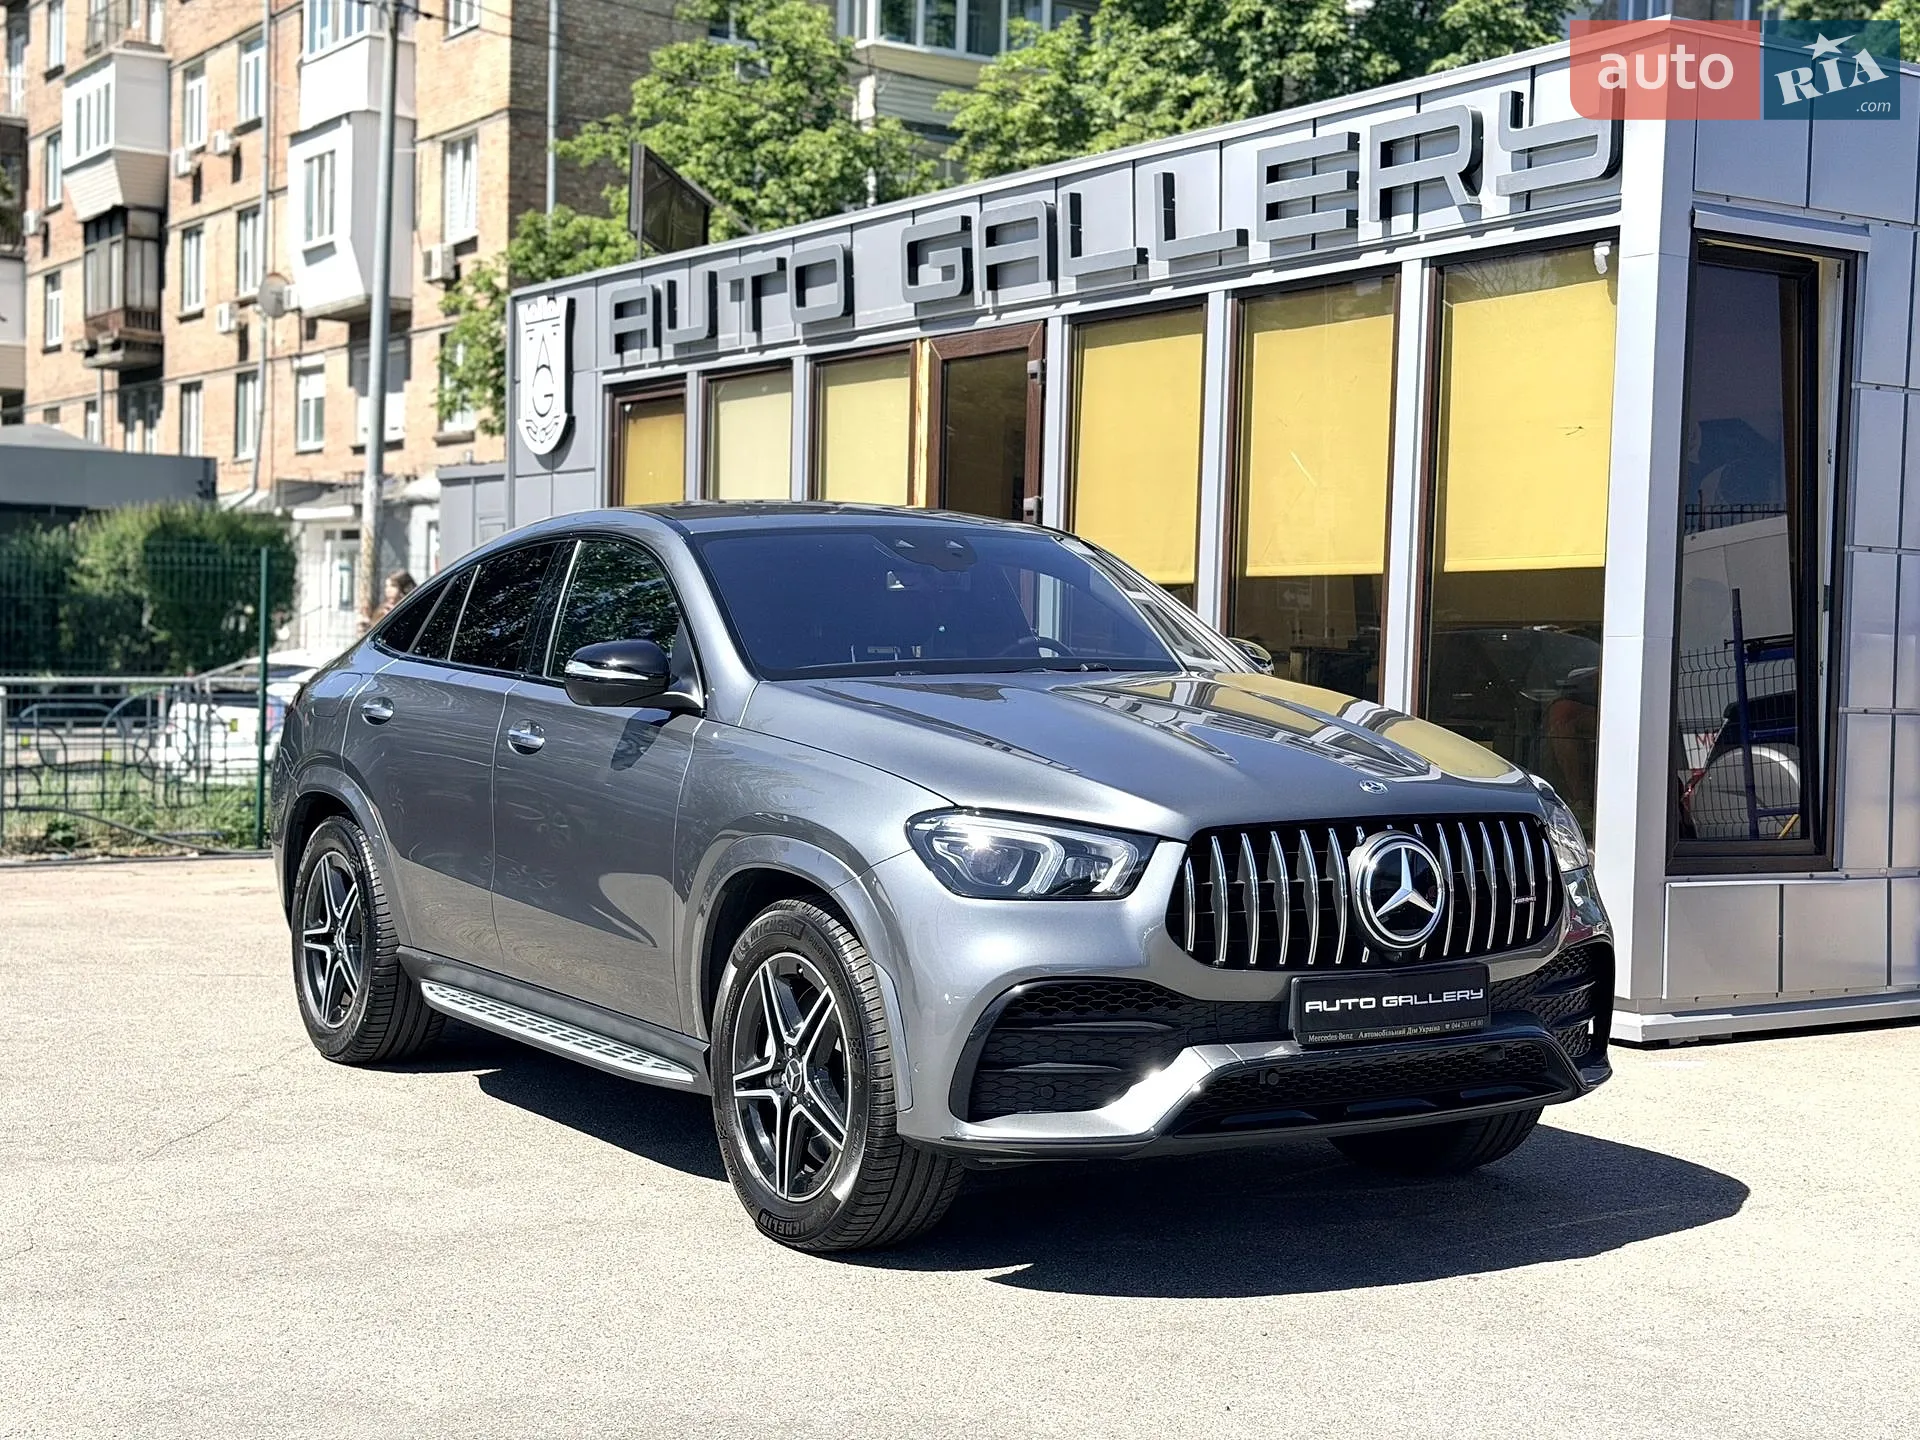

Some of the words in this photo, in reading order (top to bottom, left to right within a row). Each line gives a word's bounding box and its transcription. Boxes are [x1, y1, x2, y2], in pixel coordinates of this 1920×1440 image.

[609, 243, 854, 356] AUTO
[900, 90, 1625, 305] GALLERY
[1305, 997, 1376, 1013] AUTO
[1382, 987, 1484, 1008] GALLERY
